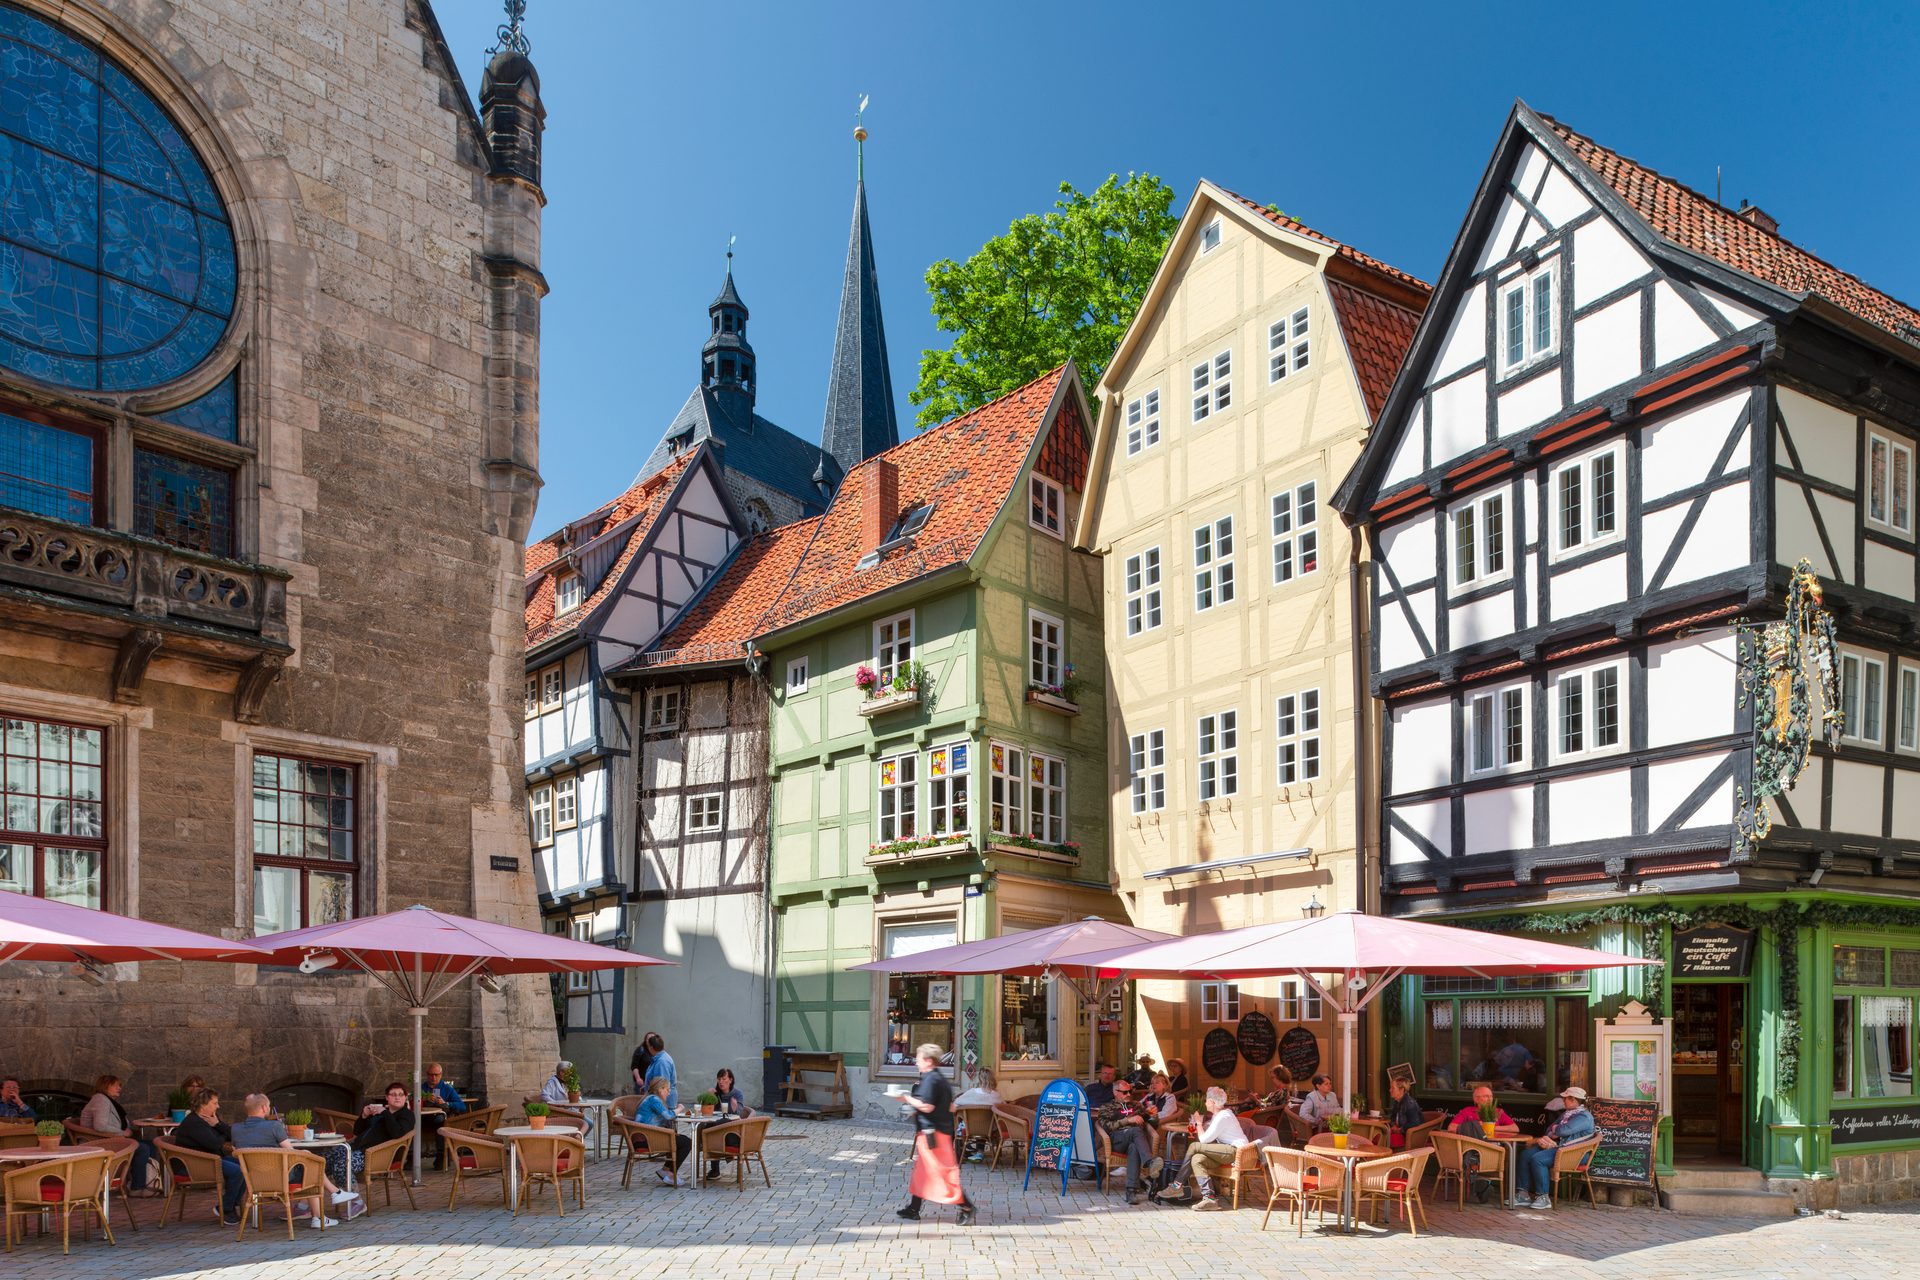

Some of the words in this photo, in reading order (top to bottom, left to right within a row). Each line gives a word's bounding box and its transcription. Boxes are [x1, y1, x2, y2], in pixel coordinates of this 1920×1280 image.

[1686, 953, 1703, 961] ein
[1705, 952, 1731, 962] Café
[1682, 964, 1692, 972] 7
[1842, 1116, 1874, 1135] Kaffeehaus
[1876, 1115, 1892, 1128] voller
